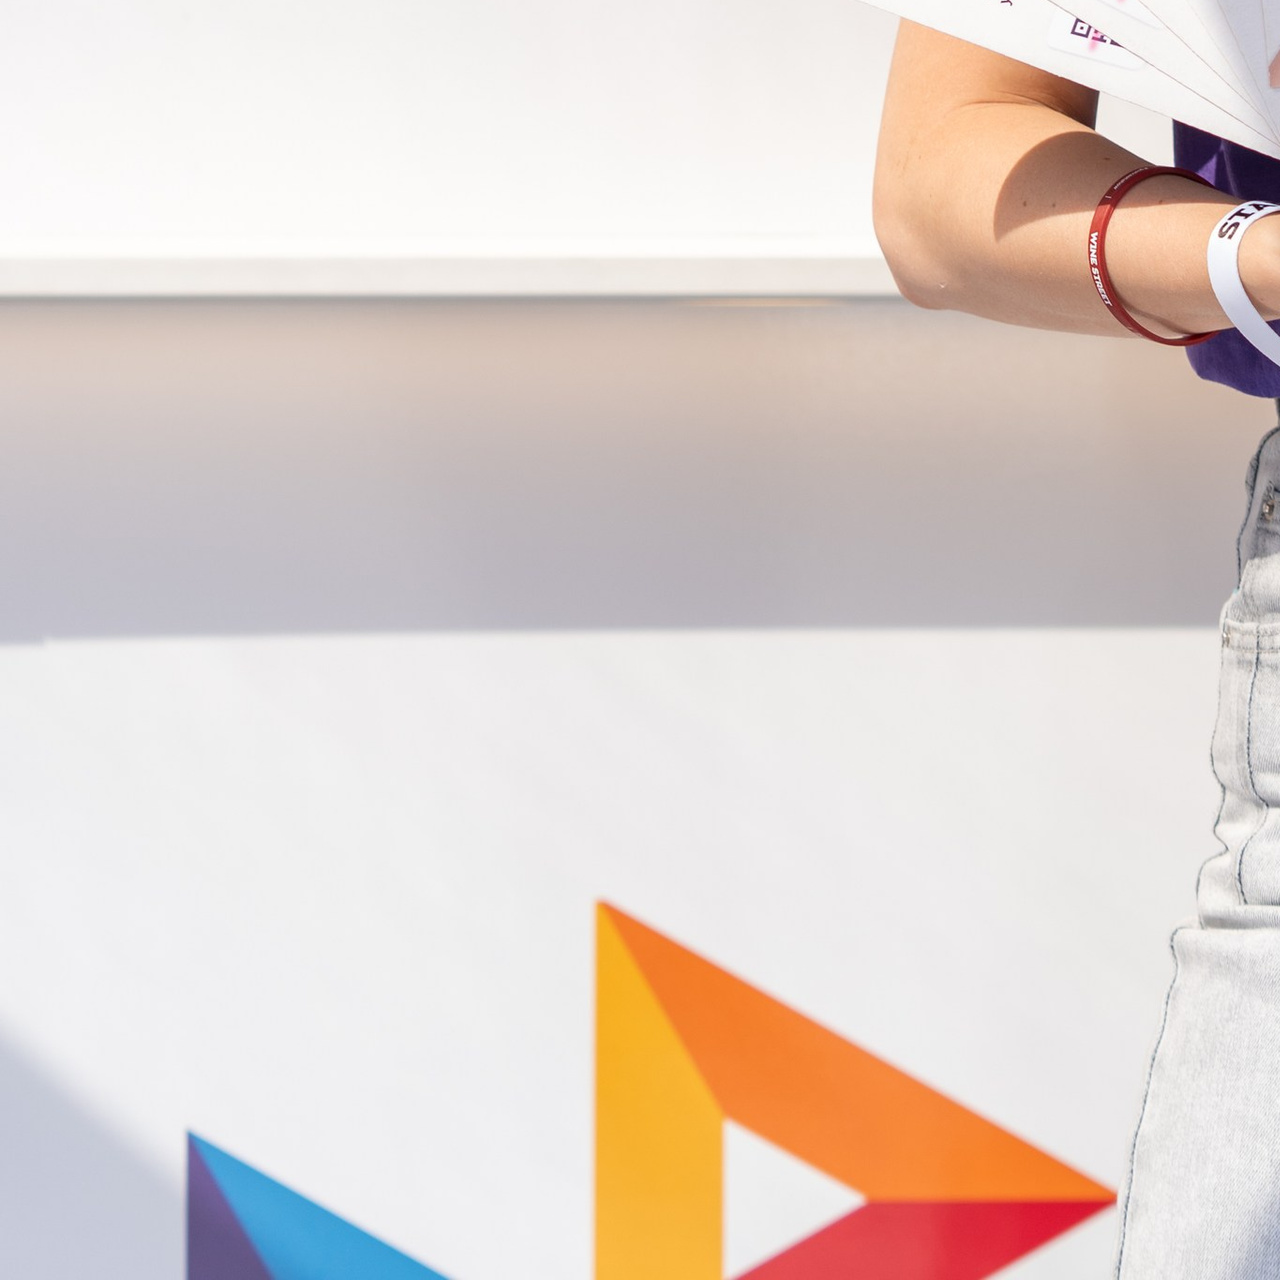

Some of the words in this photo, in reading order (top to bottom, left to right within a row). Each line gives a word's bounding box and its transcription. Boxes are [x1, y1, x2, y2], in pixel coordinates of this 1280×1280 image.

[1218, 203, 1276, 240] STA
[1090, 232, 1098, 265] WINE
[1092, 267, 1112, 307] STREET
